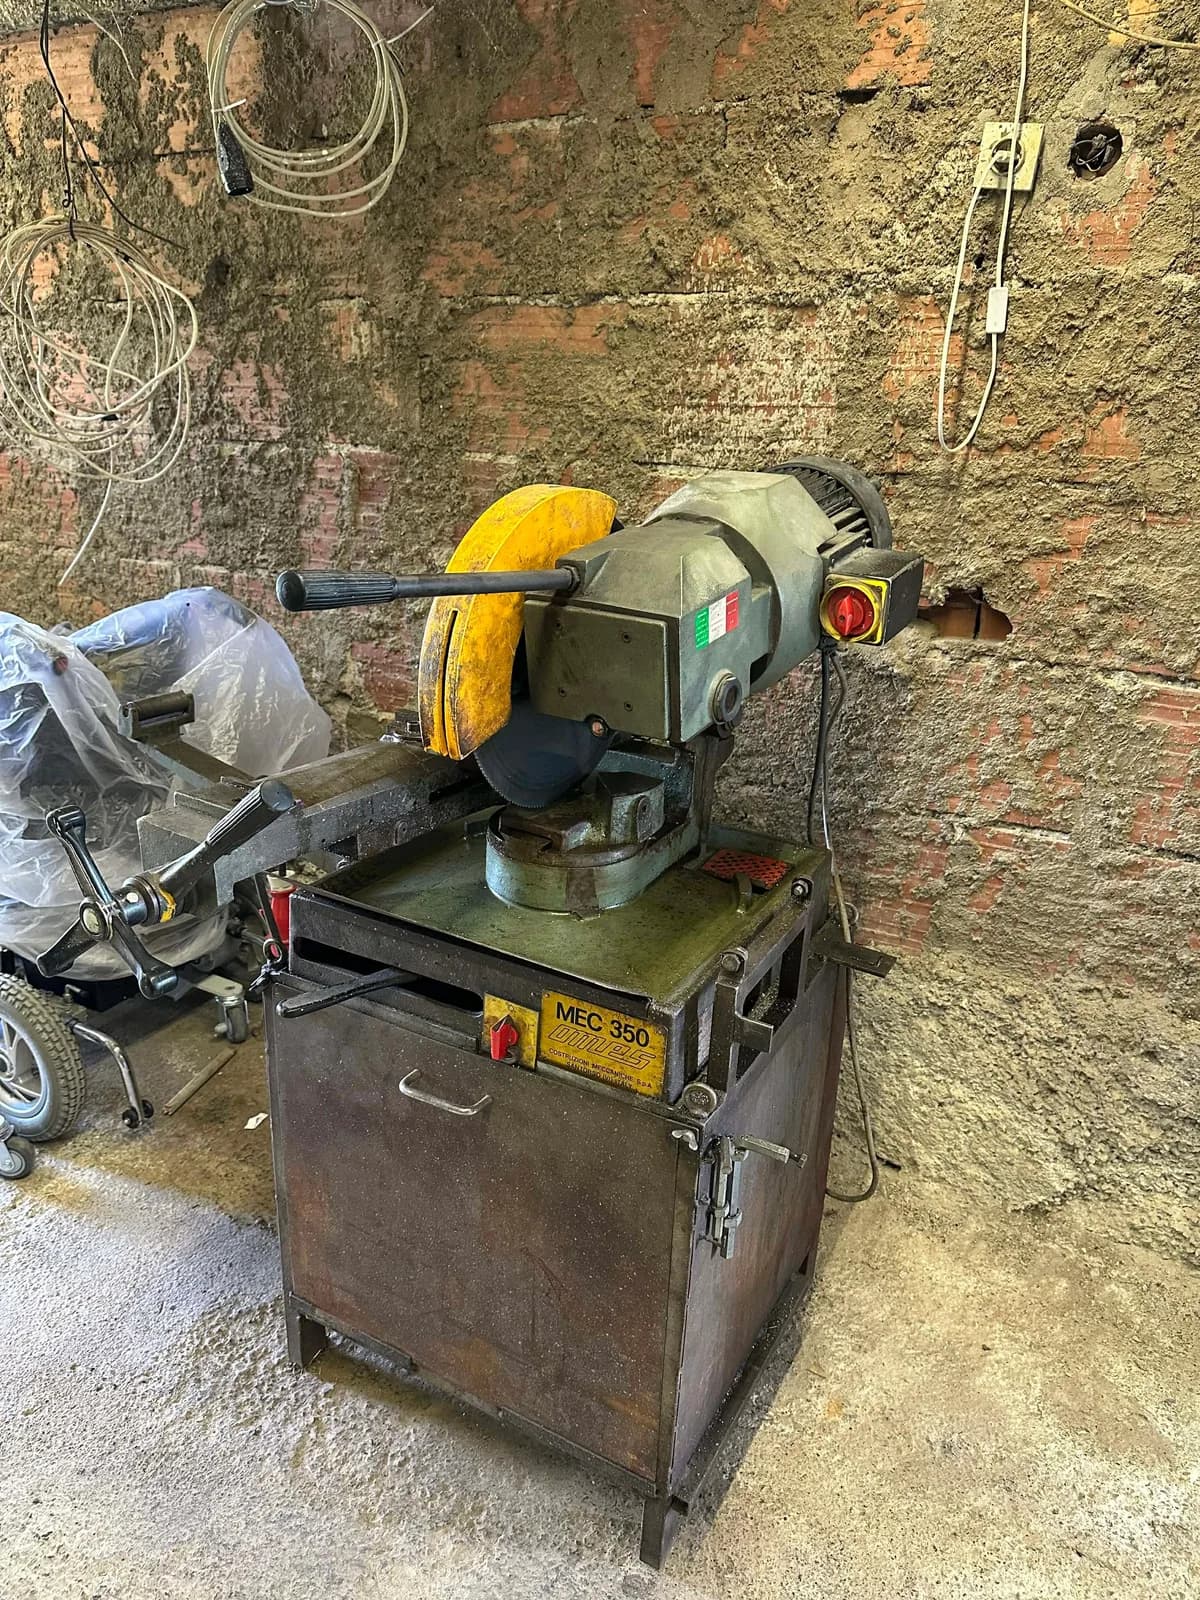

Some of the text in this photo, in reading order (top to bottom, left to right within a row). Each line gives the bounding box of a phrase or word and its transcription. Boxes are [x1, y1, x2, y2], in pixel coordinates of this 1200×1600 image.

[557, 1002, 650, 1047] MEC 350
[550, 1048, 589, 1067] COSTRUZIONI
[592, 1063, 634, 1081] MECCANICHE
